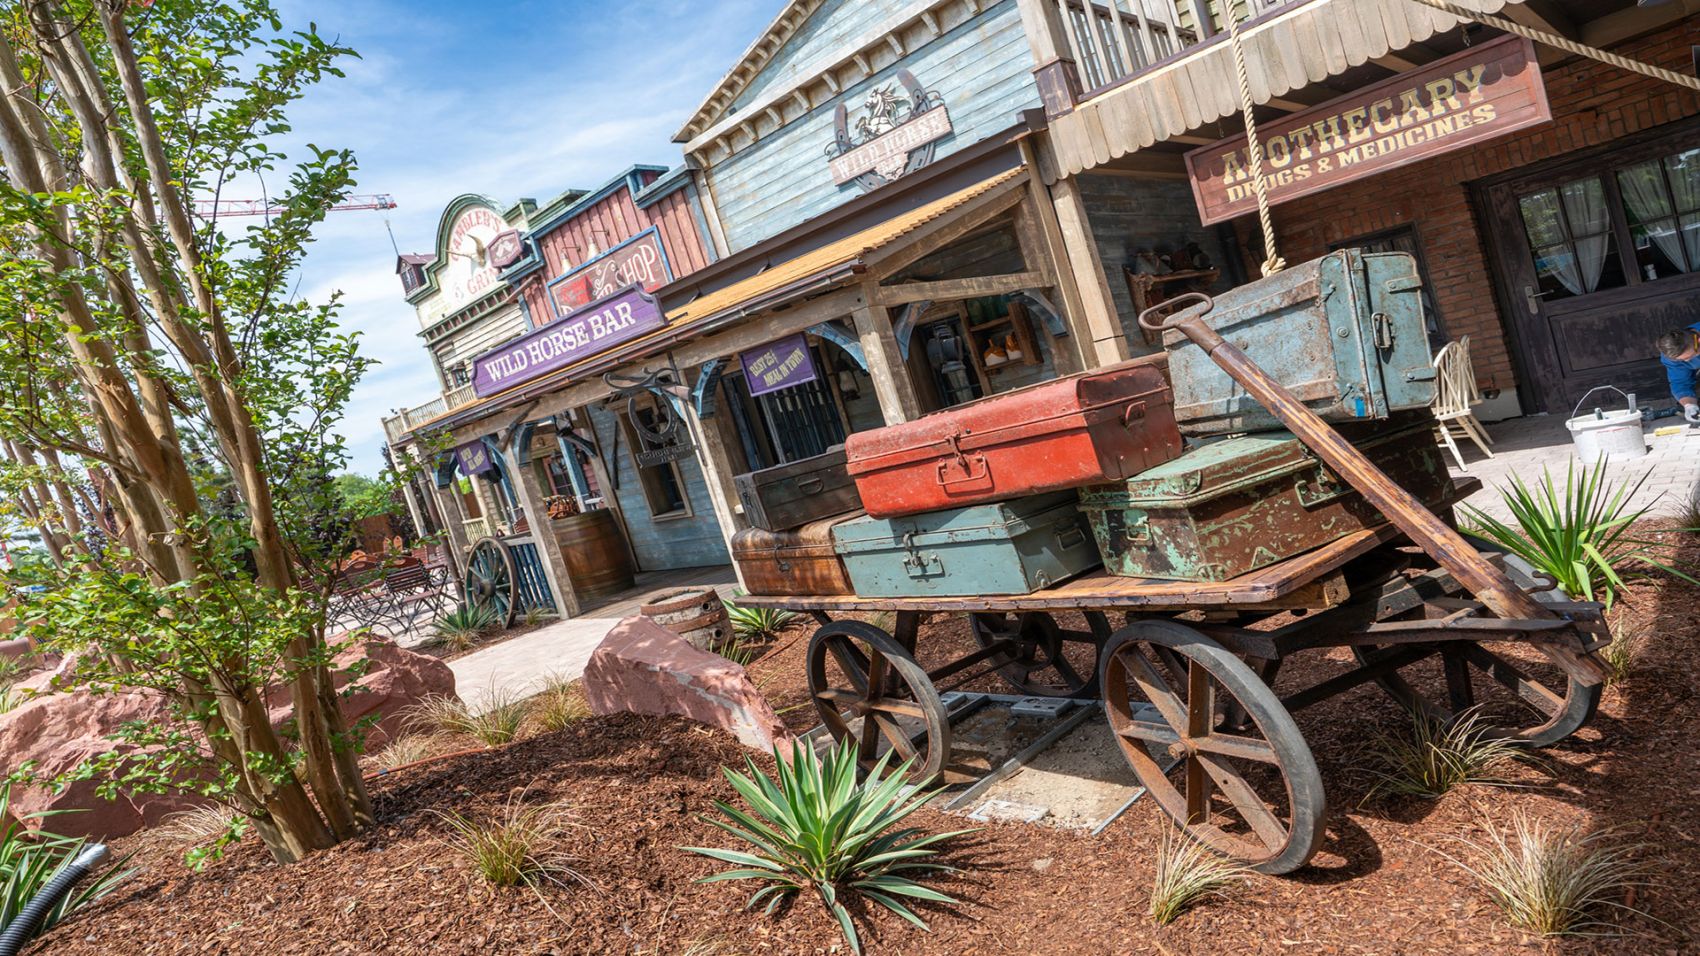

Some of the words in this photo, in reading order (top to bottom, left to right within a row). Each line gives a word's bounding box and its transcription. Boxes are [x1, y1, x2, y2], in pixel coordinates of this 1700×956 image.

[836, 144, 878, 179] WILD
[882, 112, 941, 155] HORSE
[1222, 63, 1486, 185] APOTHECARY
[1226, 162, 1312, 203] DRUGS
[1316, 156, 1334, 174] &
[1338, 104, 1497, 169] MEDICINES
[614, 244, 657, 287] SHOP
[484, 349, 528, 383] WILD
[527, 321, 591, 366] HORSE
[588, 301, 636, 340] BAR
[783, 347, 806, 372] TOWN
[748, 356, 767, 377] BEST
[763, 368, 784, 387] MEAL
[778, 362, 790, 378] IN
